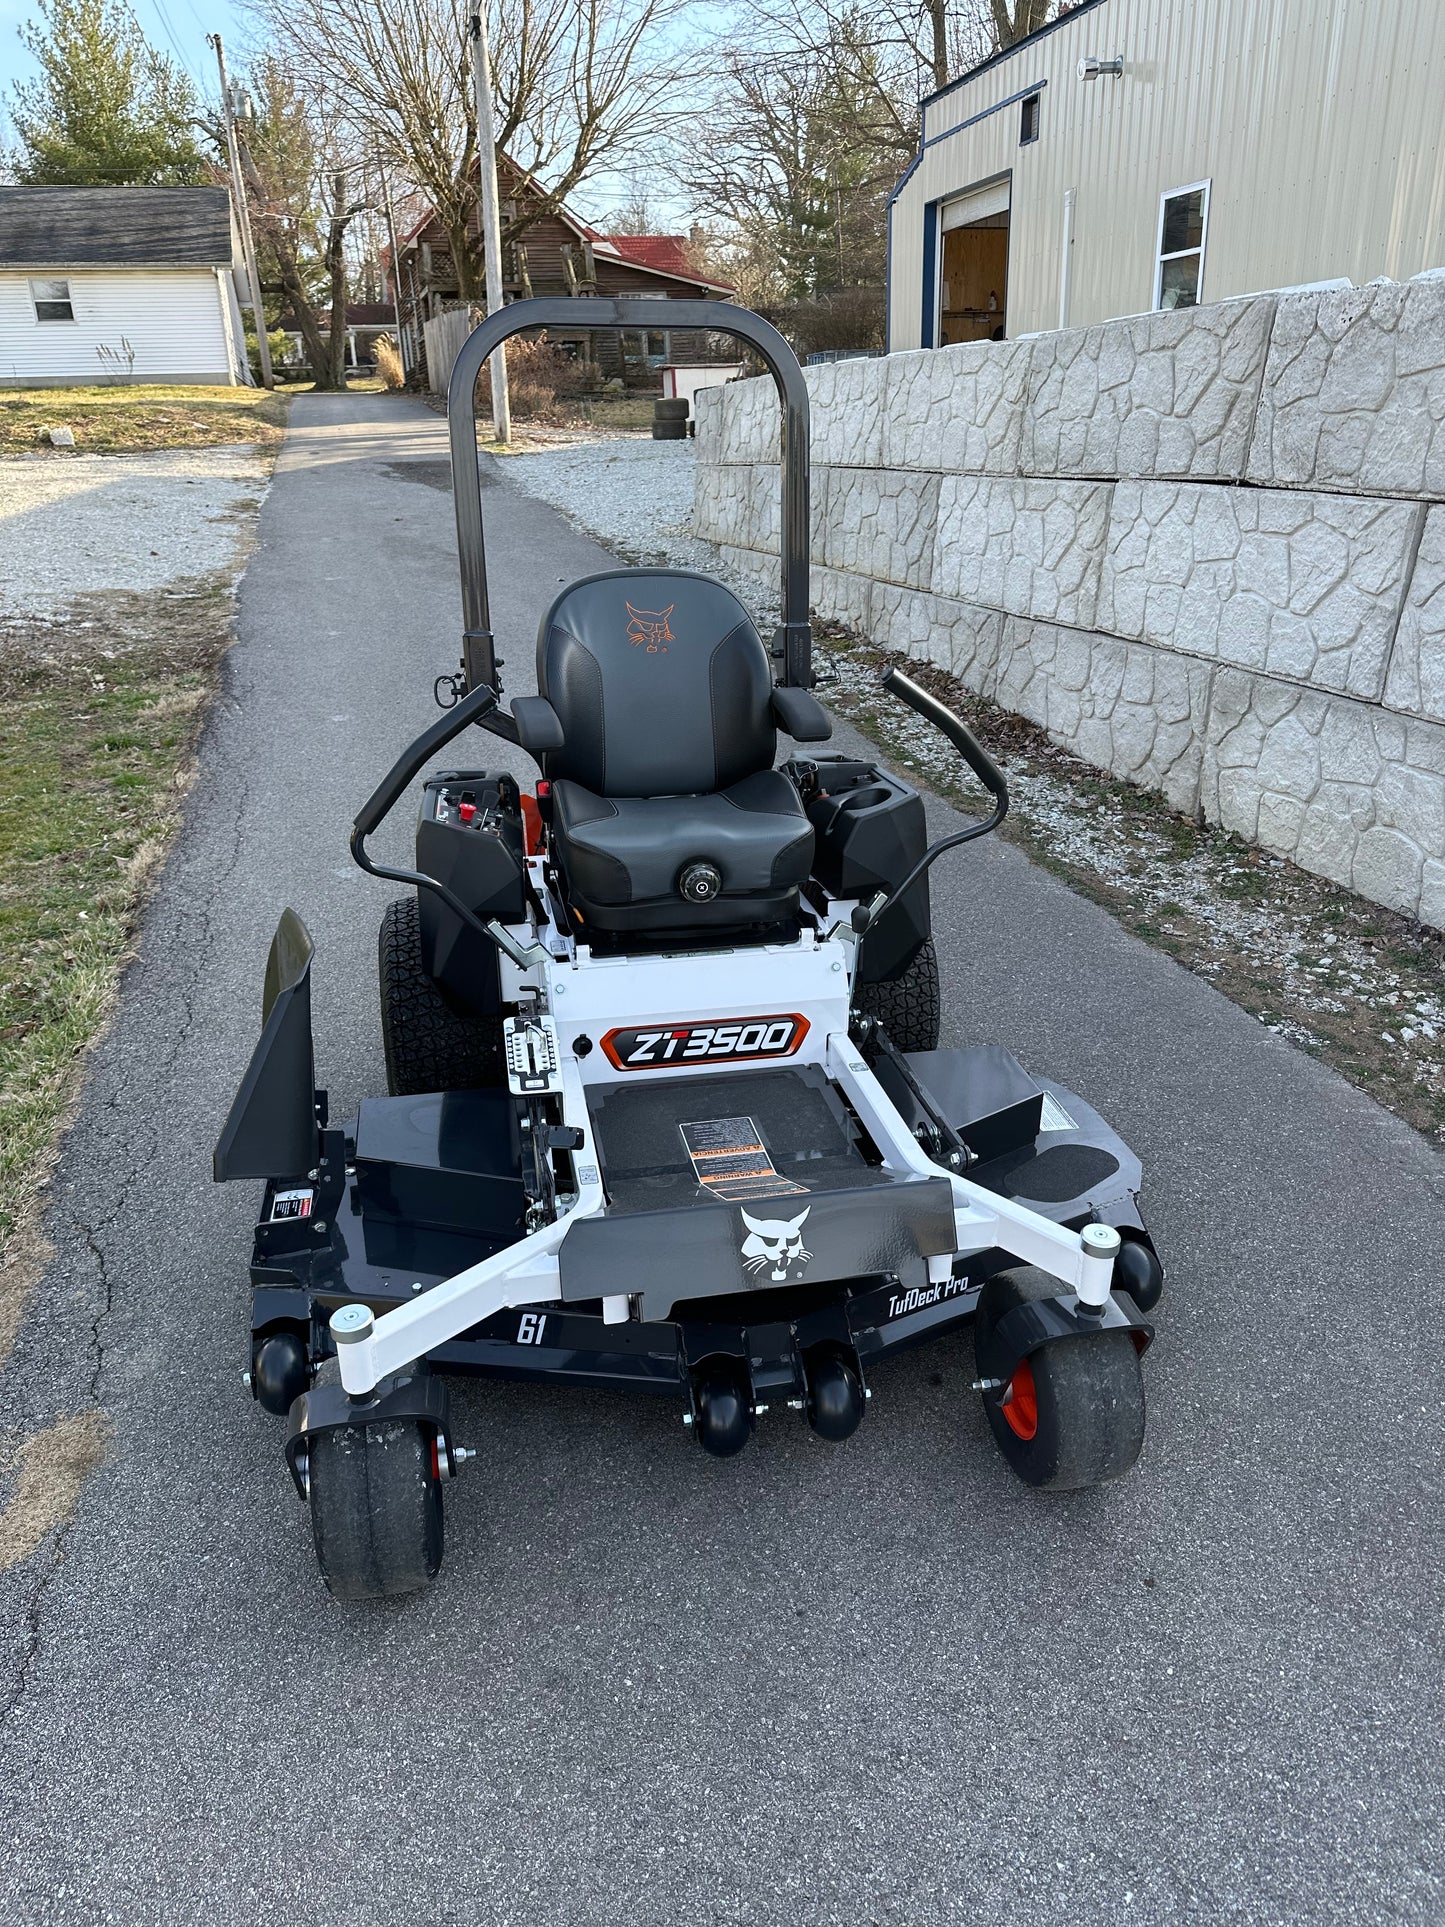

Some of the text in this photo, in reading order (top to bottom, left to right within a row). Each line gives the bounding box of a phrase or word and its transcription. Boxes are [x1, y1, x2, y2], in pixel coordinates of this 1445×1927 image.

[627, 1021, 794, 1062] ZT3500
[713, 1172, 754, 1180] WARNING
[889, 1275, 969, 1318] TufDeck Pro
[517, 1313, 547, 1345] 61
